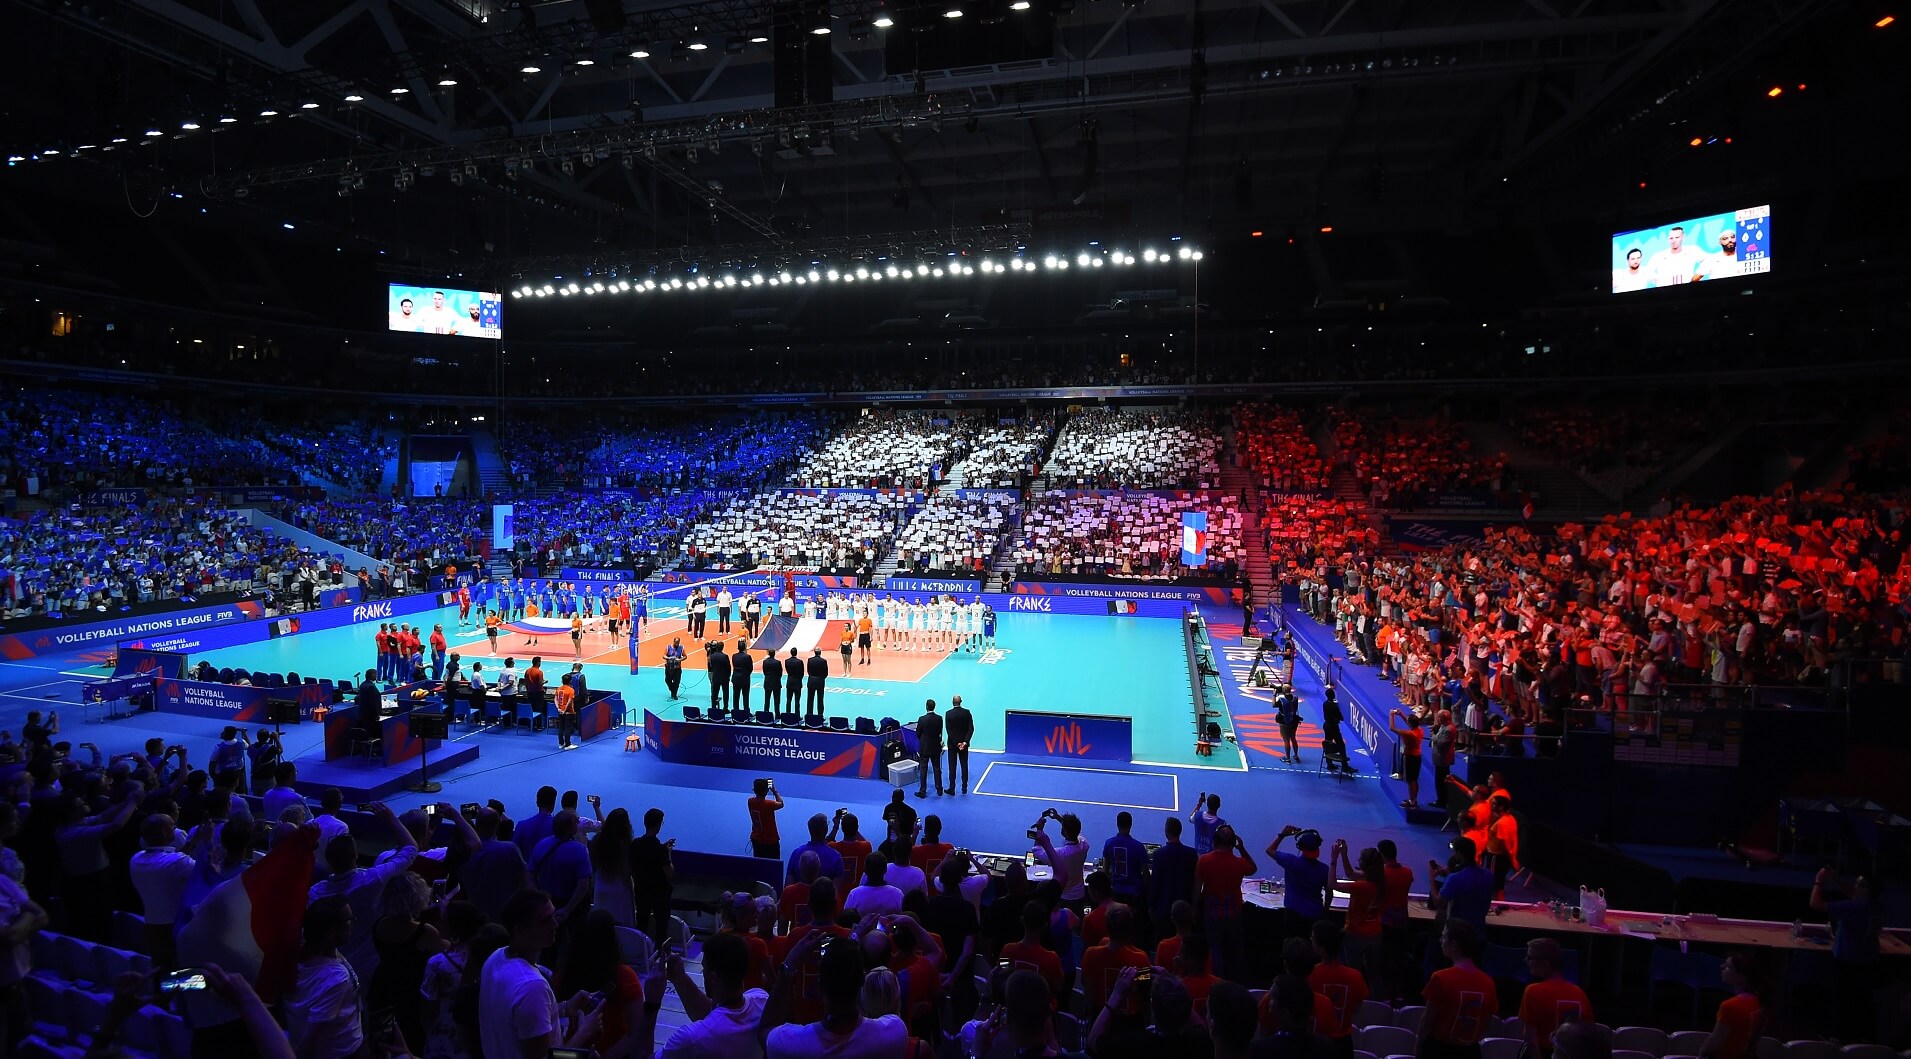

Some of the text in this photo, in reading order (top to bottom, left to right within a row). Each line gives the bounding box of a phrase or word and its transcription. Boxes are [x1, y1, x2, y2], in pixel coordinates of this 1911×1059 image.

[101, 491, 138, 504] FINALS
[1066, 588, 1113, 598] VOLLEYBALL
[1114, 590, 1149, 599] NATIONS
[1151, 592, 1182, 600] LEAGUE
[1008, 596, 1052, 612] FRANCE
[353, 601, 393, 622] FRANCE
[56, 626, 126, 645] VOLLEYBALL
[128, 619, 173, 634] NATIONS
[175, 613, 212, 626] LEAGUE
[151, 638, 187, 649] VOLLEYBALL
[178, 640, 200, 650] LEAGUE
[184, 687, 225, 699] VOLLEYBALL
[184, 697, 243, 710] NATIONS LEAGUE
[1349, 701, 1379, 754] THE FINALS
[735, 734, 800, 748] VOLLEYBALL
[1044, 722, 1092, 756] VNL
[735, 745, 826, 761] NATIONS LEAGUE
